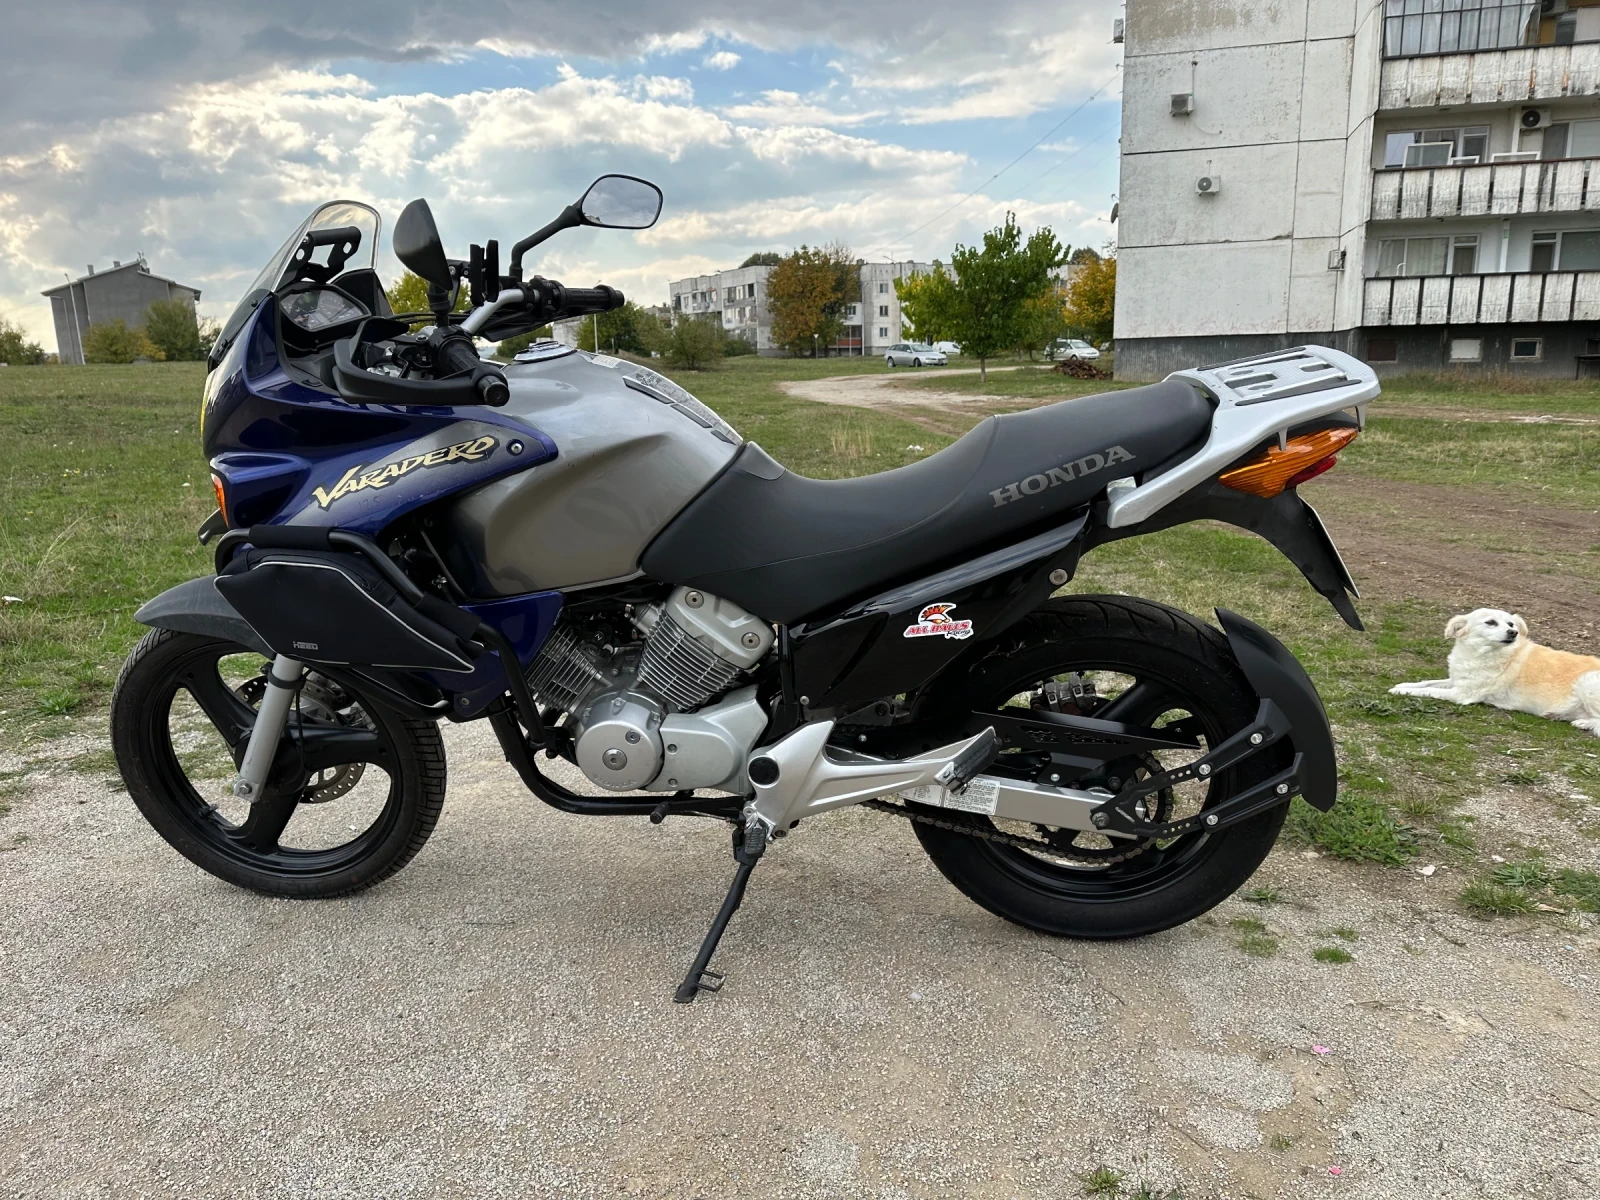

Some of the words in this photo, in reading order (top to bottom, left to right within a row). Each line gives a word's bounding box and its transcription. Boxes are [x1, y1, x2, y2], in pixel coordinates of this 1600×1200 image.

[312, 436, 495, 508] VARADERO
[989, 445, 1136, 508] HONDA
[905, 626, 929, 636] ALL
[930, 621, 970, 632] BALLS
